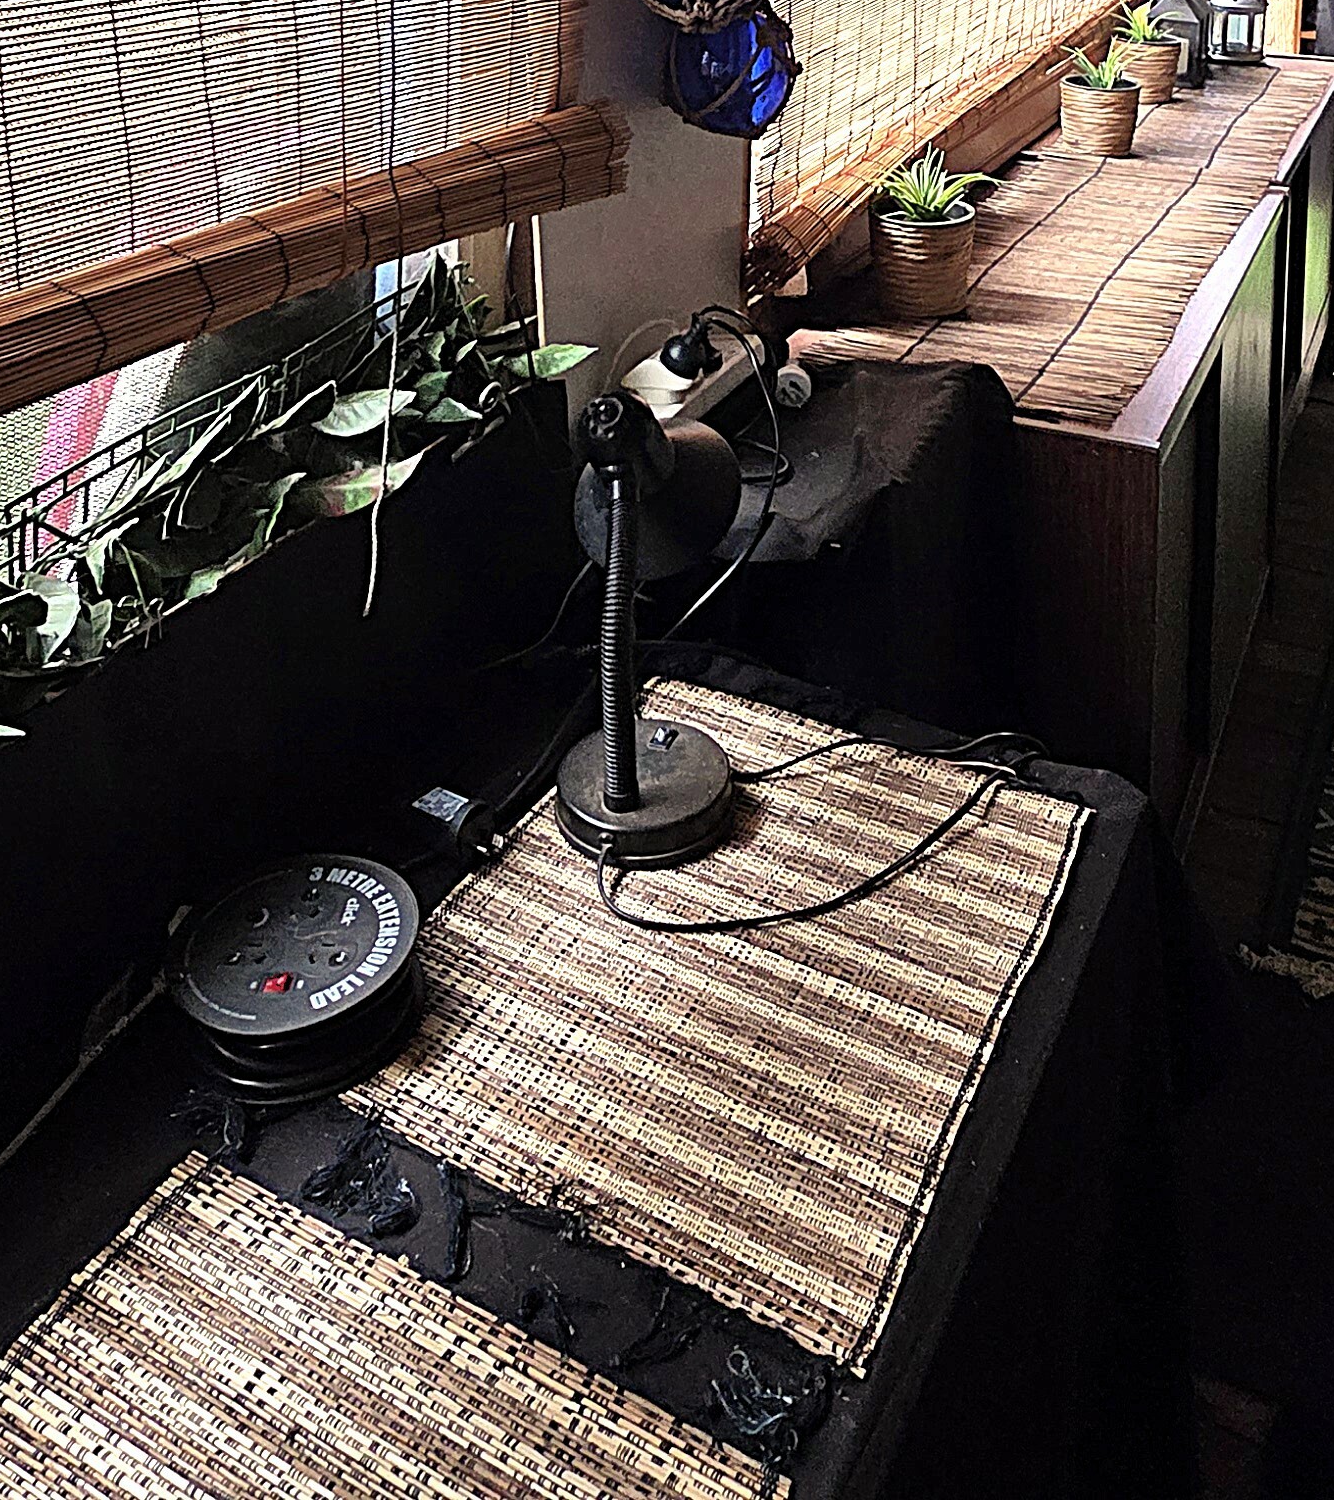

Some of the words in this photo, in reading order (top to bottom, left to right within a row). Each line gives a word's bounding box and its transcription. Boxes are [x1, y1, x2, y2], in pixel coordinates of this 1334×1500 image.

[309, 867, 324, 881] 3
[326, 868, 385, 899] METRE
[356, 893, 401, 977] EXTENSION
[309, 974, 365, 1009] LEAD
